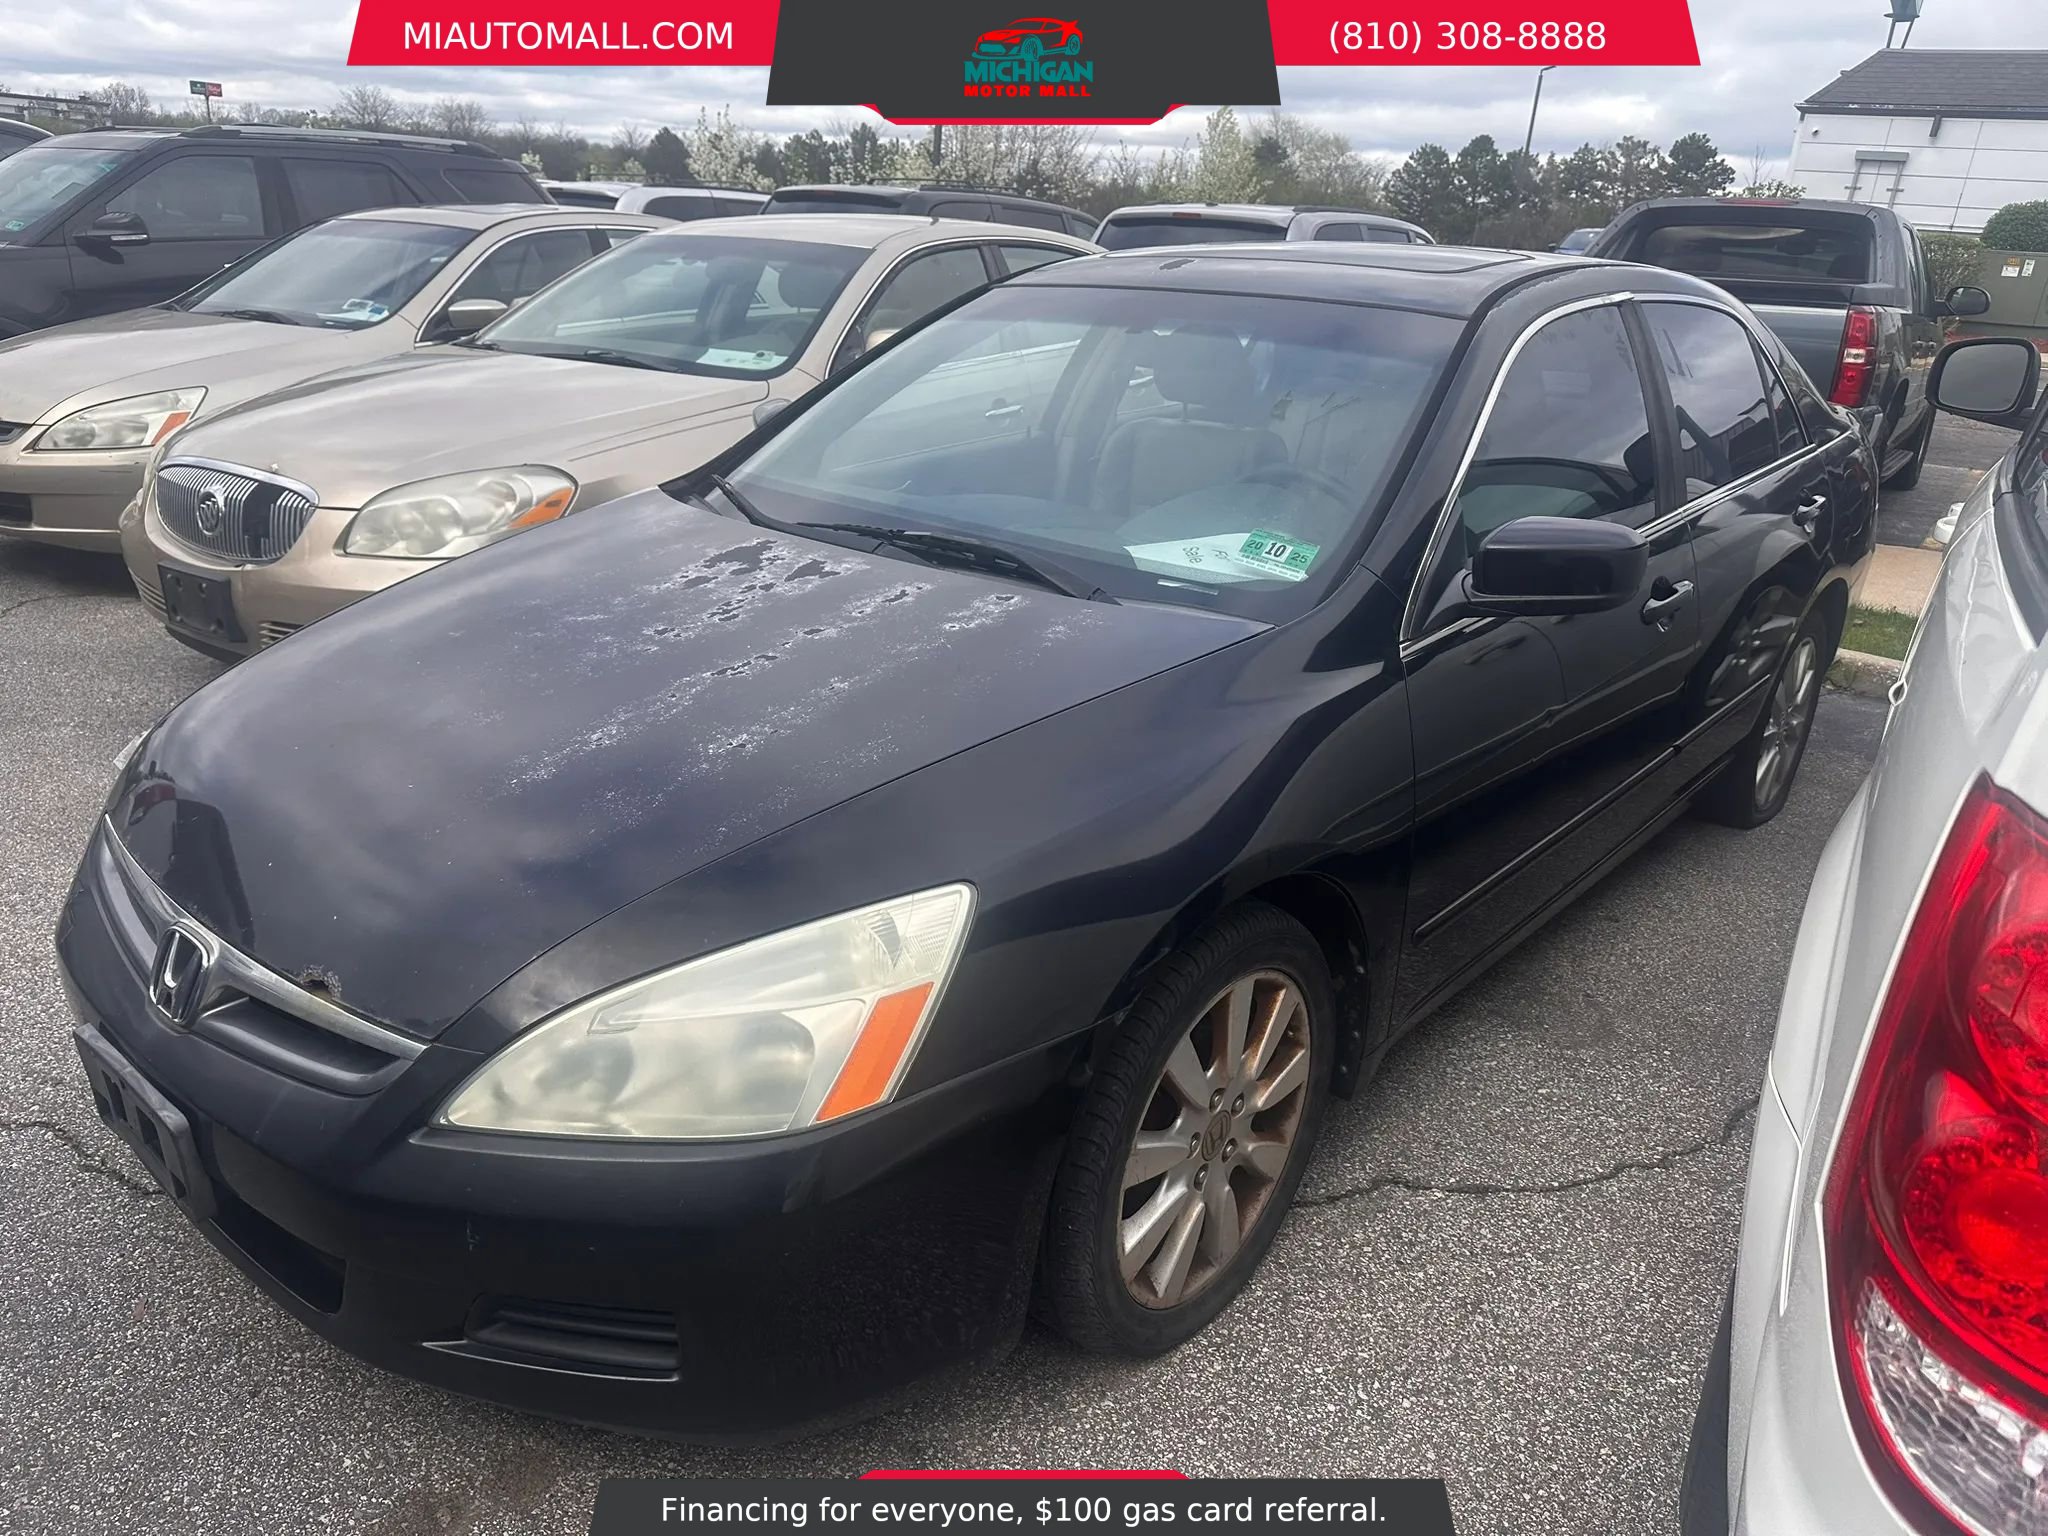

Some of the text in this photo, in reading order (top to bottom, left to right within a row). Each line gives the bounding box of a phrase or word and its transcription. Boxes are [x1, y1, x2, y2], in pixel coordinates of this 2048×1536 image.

[1247, 539, 1264, 551] 20
[1264, 541, 1288, 558] 10
[1290, 552, 1310, 564] 25
